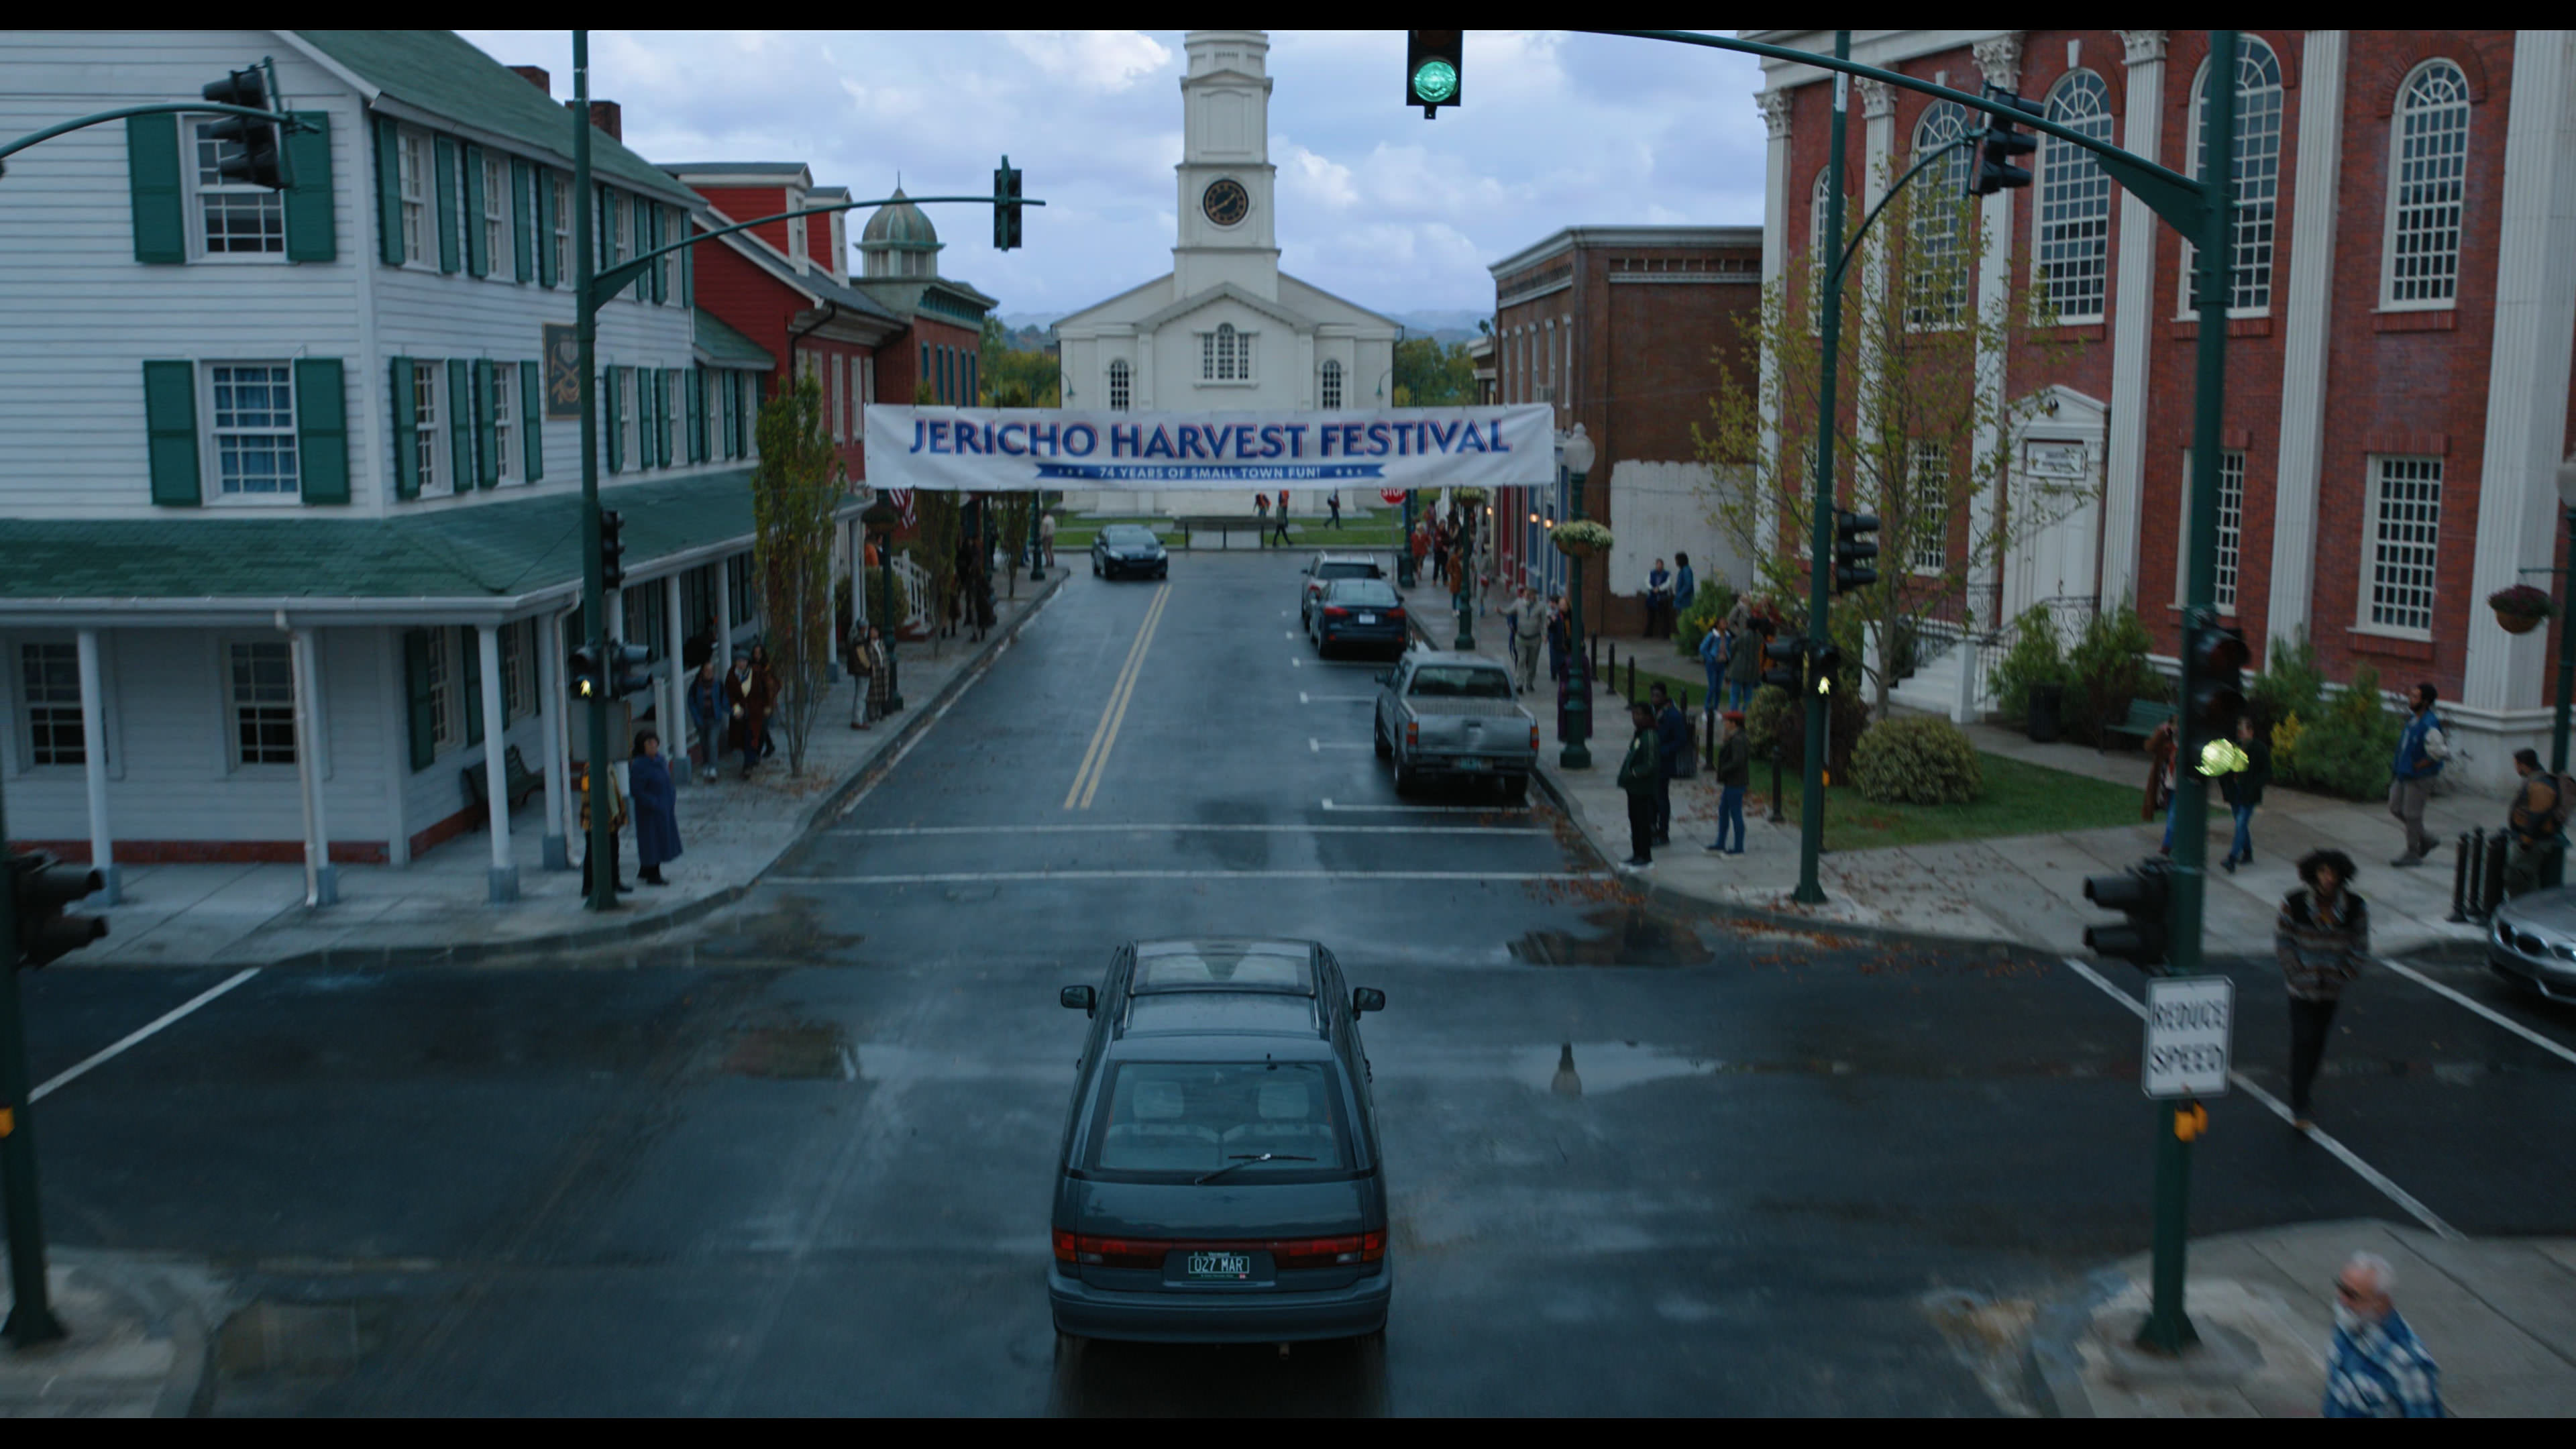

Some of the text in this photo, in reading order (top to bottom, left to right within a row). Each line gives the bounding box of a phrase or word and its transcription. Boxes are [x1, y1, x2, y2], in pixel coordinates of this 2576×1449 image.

[910, 418, 1513, 460] JERICHO HARVEST FESTIVAL
[1100, 467, 1320, 478] 74 YEARS OF SMALL TOWN FUN!
[1382, 488, 1405, 496] STOP
[2152, 1000, 2227, 1030] REDUCE
[2151, 1043, 2224, 1075] SPEED
[1194, 1258, 1243, 1273] 027 MAR
